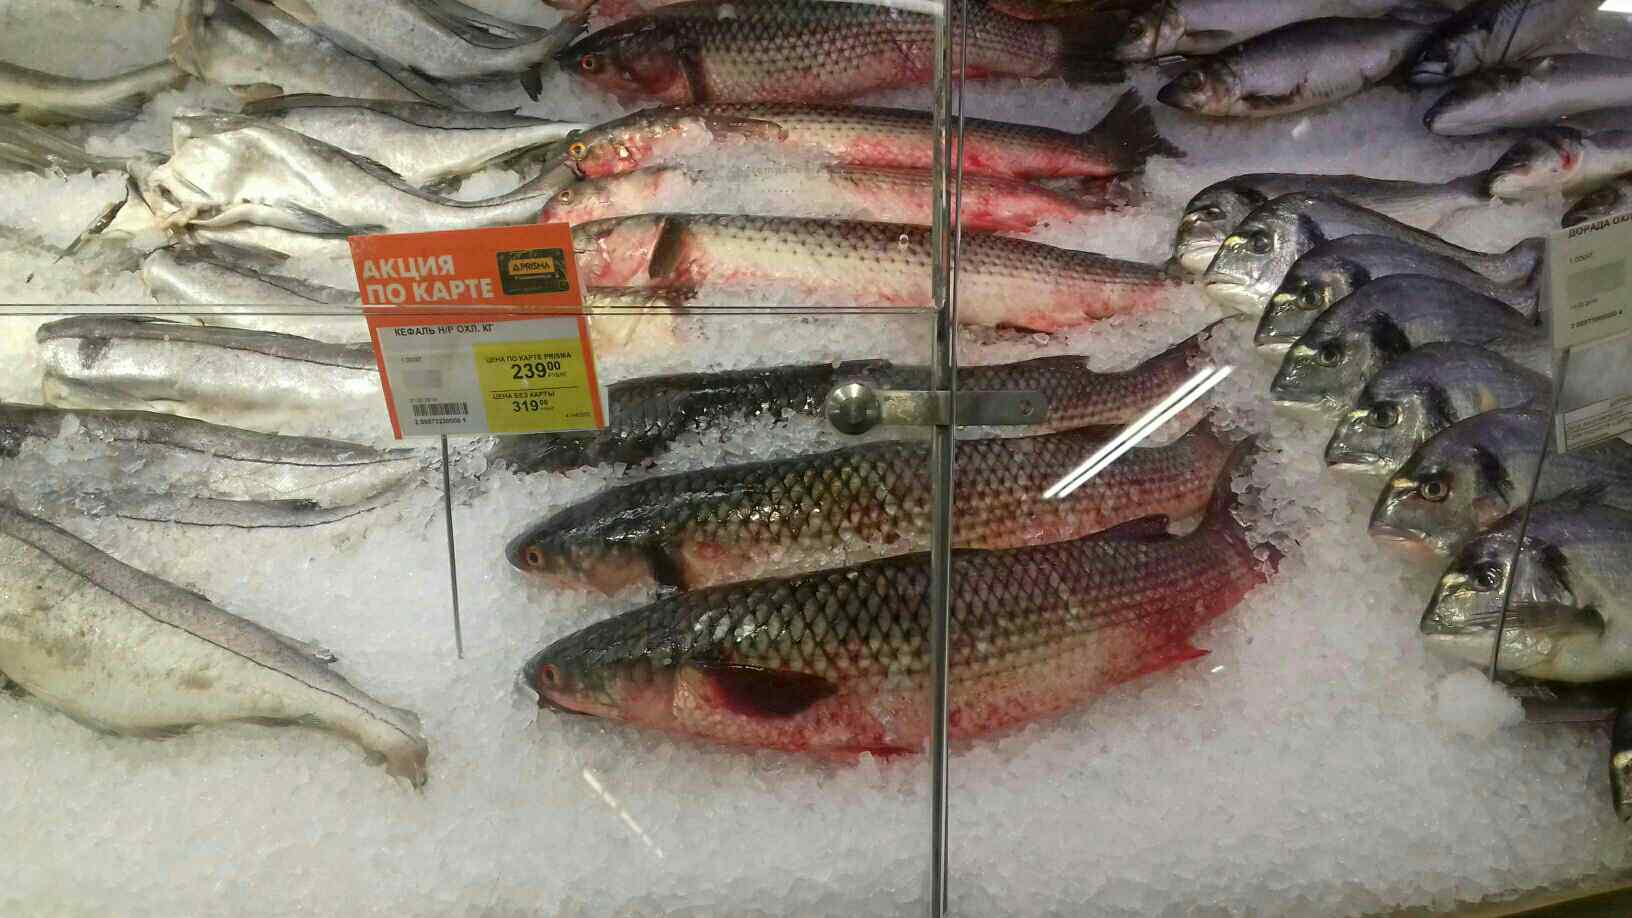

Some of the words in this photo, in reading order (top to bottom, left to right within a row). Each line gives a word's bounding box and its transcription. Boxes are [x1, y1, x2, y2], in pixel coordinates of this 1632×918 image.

[1568, 219, 1610, 239] ДОРАДА
[363, 255, 455, 280] АКЦИЯ
[367, 283, 406, 304] ПО
[412, 278, 495, 302] КАРТЕ
[394, 326, 436, 336] КЕФАЛЬ
[482, 323, 495, 332] КГ
[544, 351, 572, 360] PRISMA
[511, 361, 547, 380] 239
[547, 361, 560, 371] 00
[512, 399, 539, 413] 319
